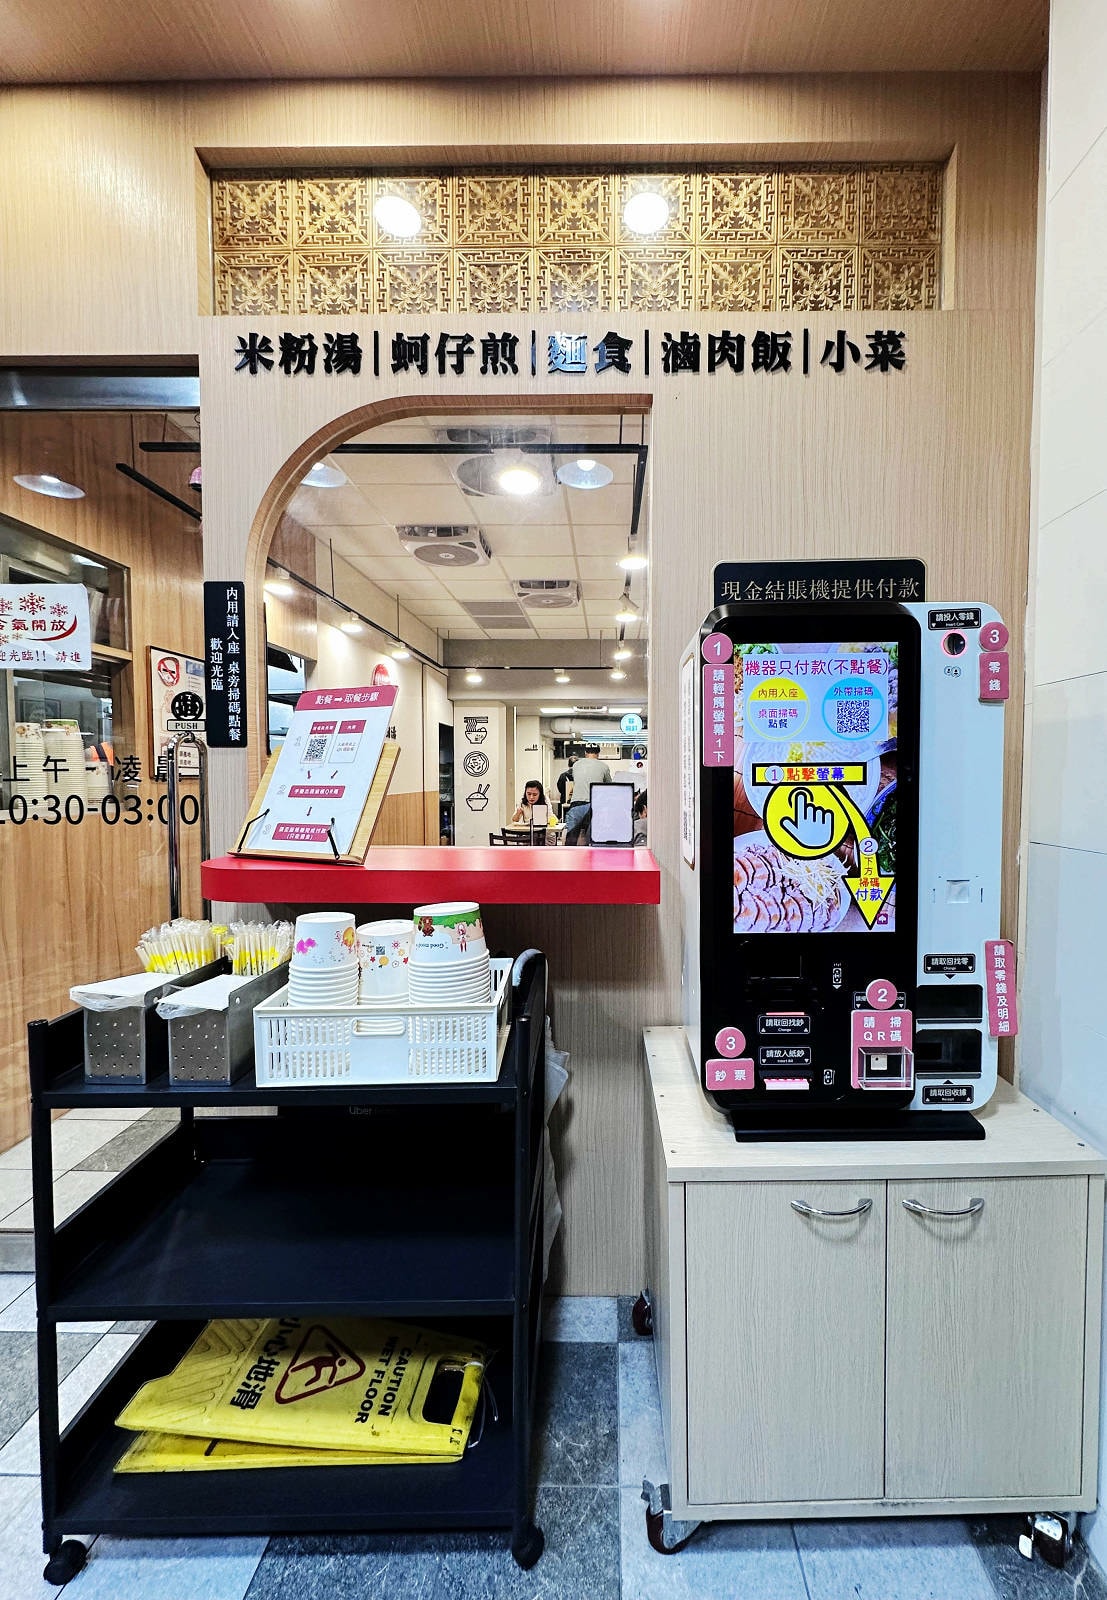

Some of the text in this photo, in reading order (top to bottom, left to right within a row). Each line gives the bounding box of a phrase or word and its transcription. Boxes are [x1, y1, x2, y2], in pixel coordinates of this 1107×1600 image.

[233, 331, 907, 375] 米粉湯 蚵仔煎 麵食 滷肉飯 小菜
[935, 612, 975, 622] 請投入零錢
[989, 629, 1000, 644] 3
[713, 641, 721, 656] 1
[56, 651, 82, 662] 請進
[210, 638, 224, 691] 歡迎光臨
[745, 658, 889, 676] 機器只付款(不點餐)
[988, 661, 1001, 691] 零錢
[315, 691, 379, 704] 點餐 取餐步驟
[833, 687, 874, 696] 外帶掃碼
[227, 662, 242, 741] 桌旁掃碼點餐
[758, 709, 798, 718] 桌面掃碼
[175, 722, 198, 730] PUSH
[768, 719, 788, 729] 點餐
[3, 756, 69, 783] 上午
[787, 767, 845, 781] 點擊螢幕
[0, 794, 199, 825] 0:30-03:00
[864, 840, 873, 852] 2
[864, 857, 873, 875] 下方
[860, 877, 880, 887] 掃碼
[855, 888, 884, 901] 付款
[931, 957, 969, 966] 請取回找零
[877, 988, 888, 1002] 2
[993, 945, 1010, 1032] 請取零錢及明細
[765, 1018, 805, 1027] 請取回找鈔
[725, 1036, 736, 1050] 3
[766, 1049, 805, 1058] 請放入紙鈔
[929, 1088, 967, 1097] 請取回收據
[355, 1336, 399, 1424] WET FLOOR
[377, 1347, 412, 1417] CAUTION
